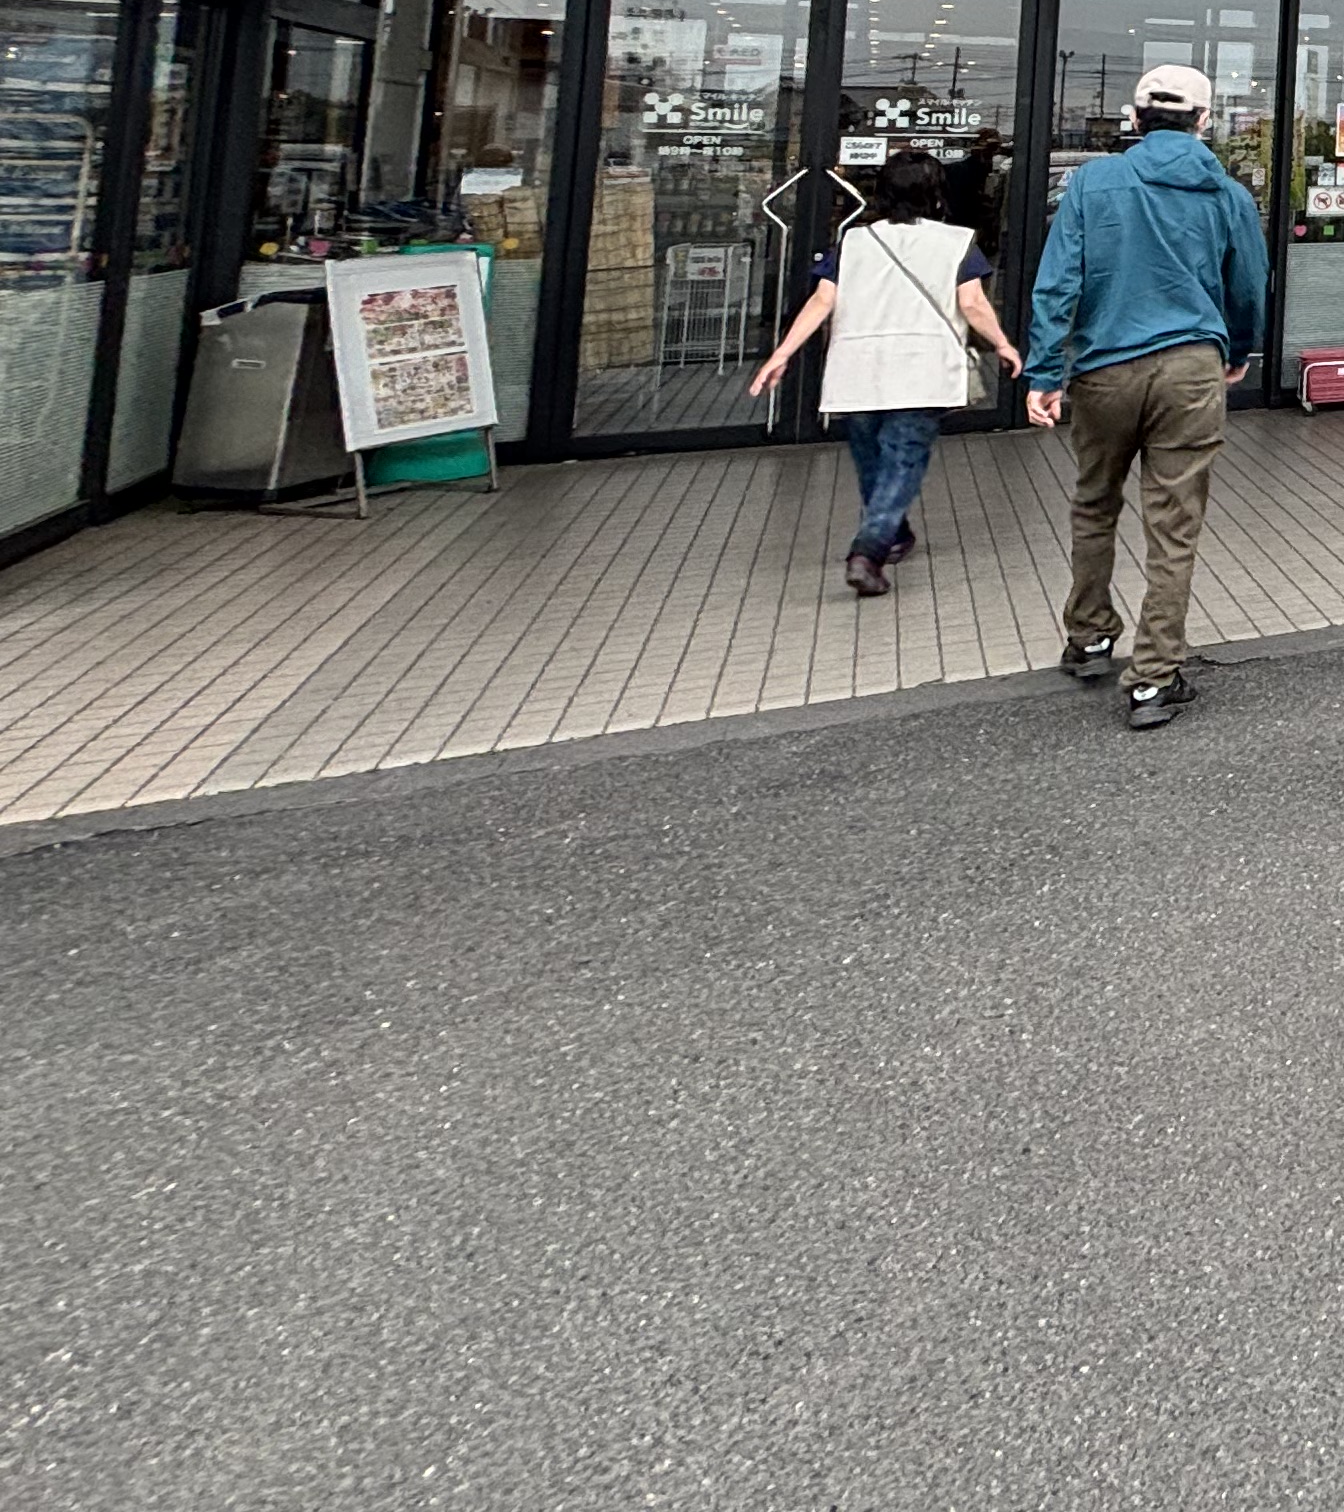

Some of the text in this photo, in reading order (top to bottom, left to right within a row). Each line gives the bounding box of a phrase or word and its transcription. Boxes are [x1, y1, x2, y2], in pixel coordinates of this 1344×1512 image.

[690, 102, 765, 122] Smile
[916, 107, 981, 125] Smile
[683, 135, 722, 145] OPEN
[910, 138, 944, 148] OPEN
